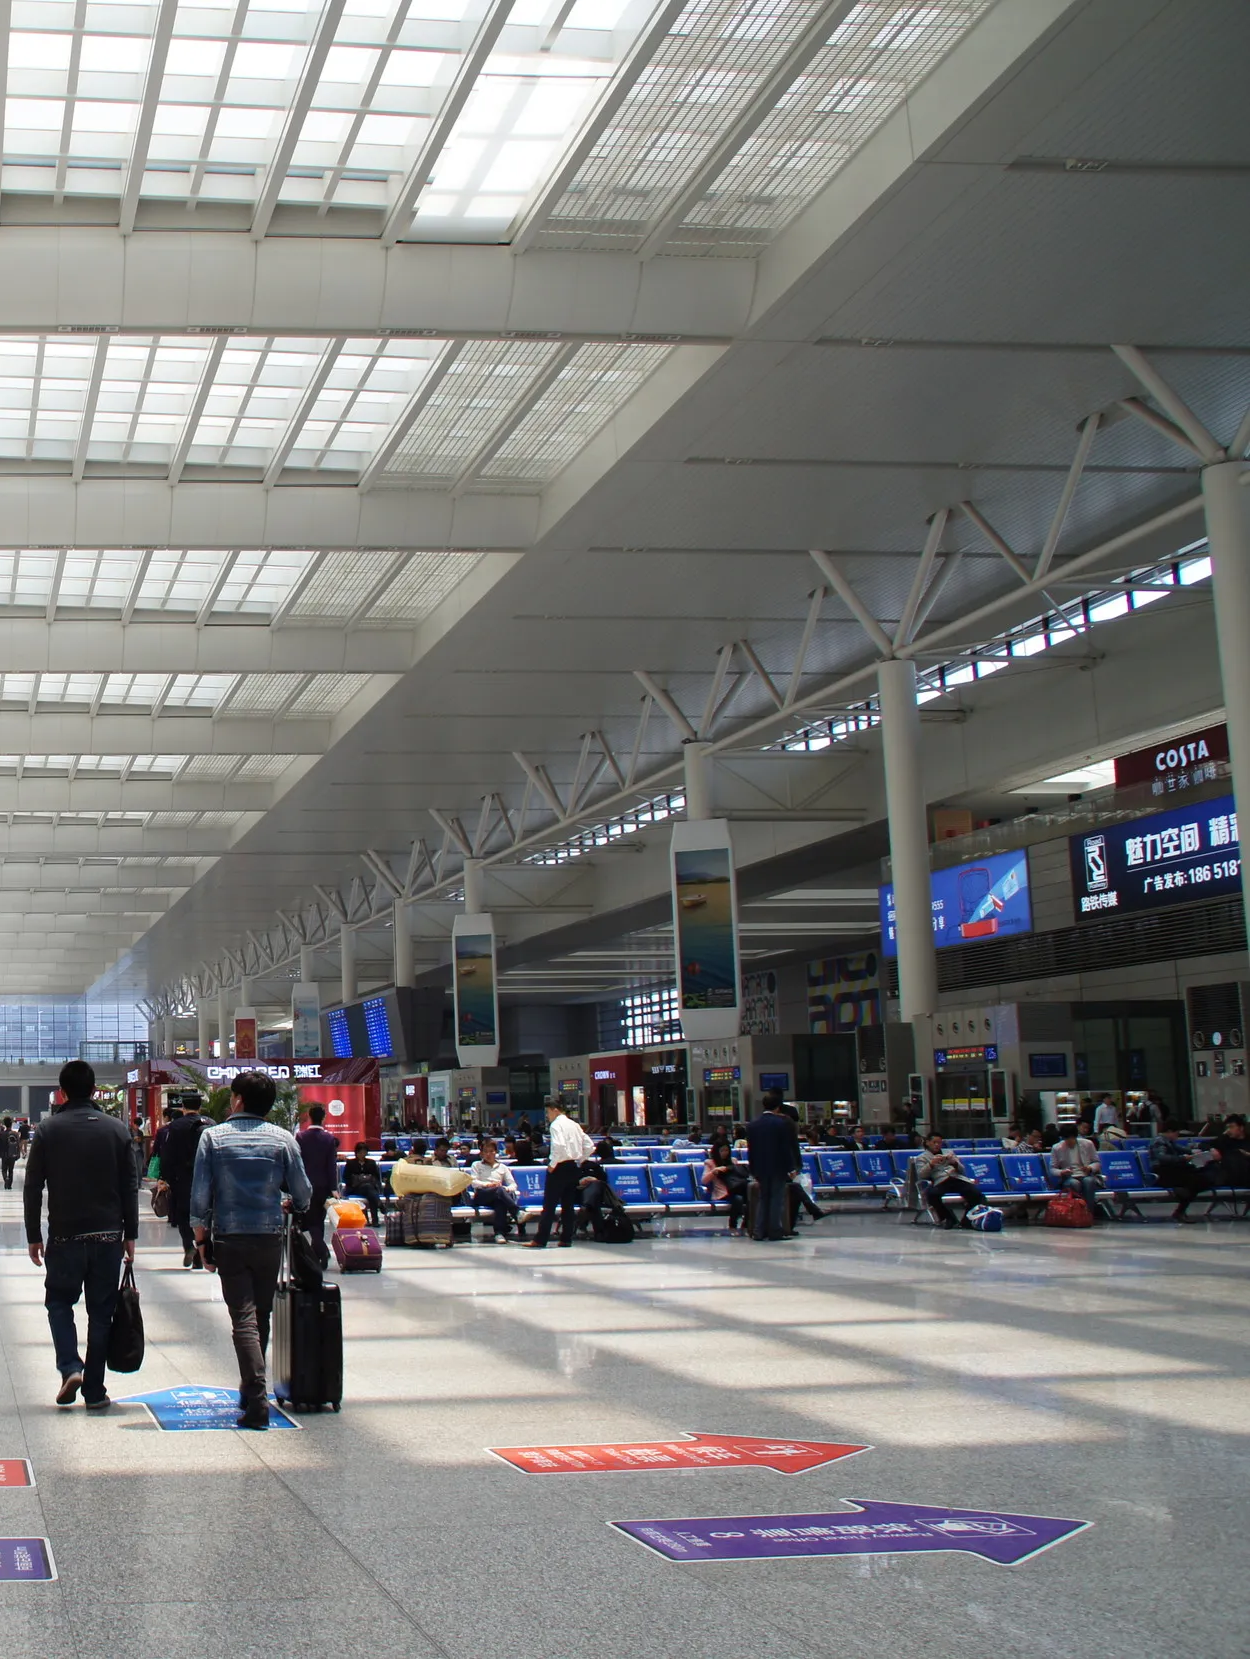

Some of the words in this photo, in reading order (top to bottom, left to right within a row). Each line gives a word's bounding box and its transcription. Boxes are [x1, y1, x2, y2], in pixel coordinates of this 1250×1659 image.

[1155, 740, 1210, 771] COSTA
[1125, 822, 1200, 866] 魅力空间
[1081, 891, 1118, 912] 路铁传媒
